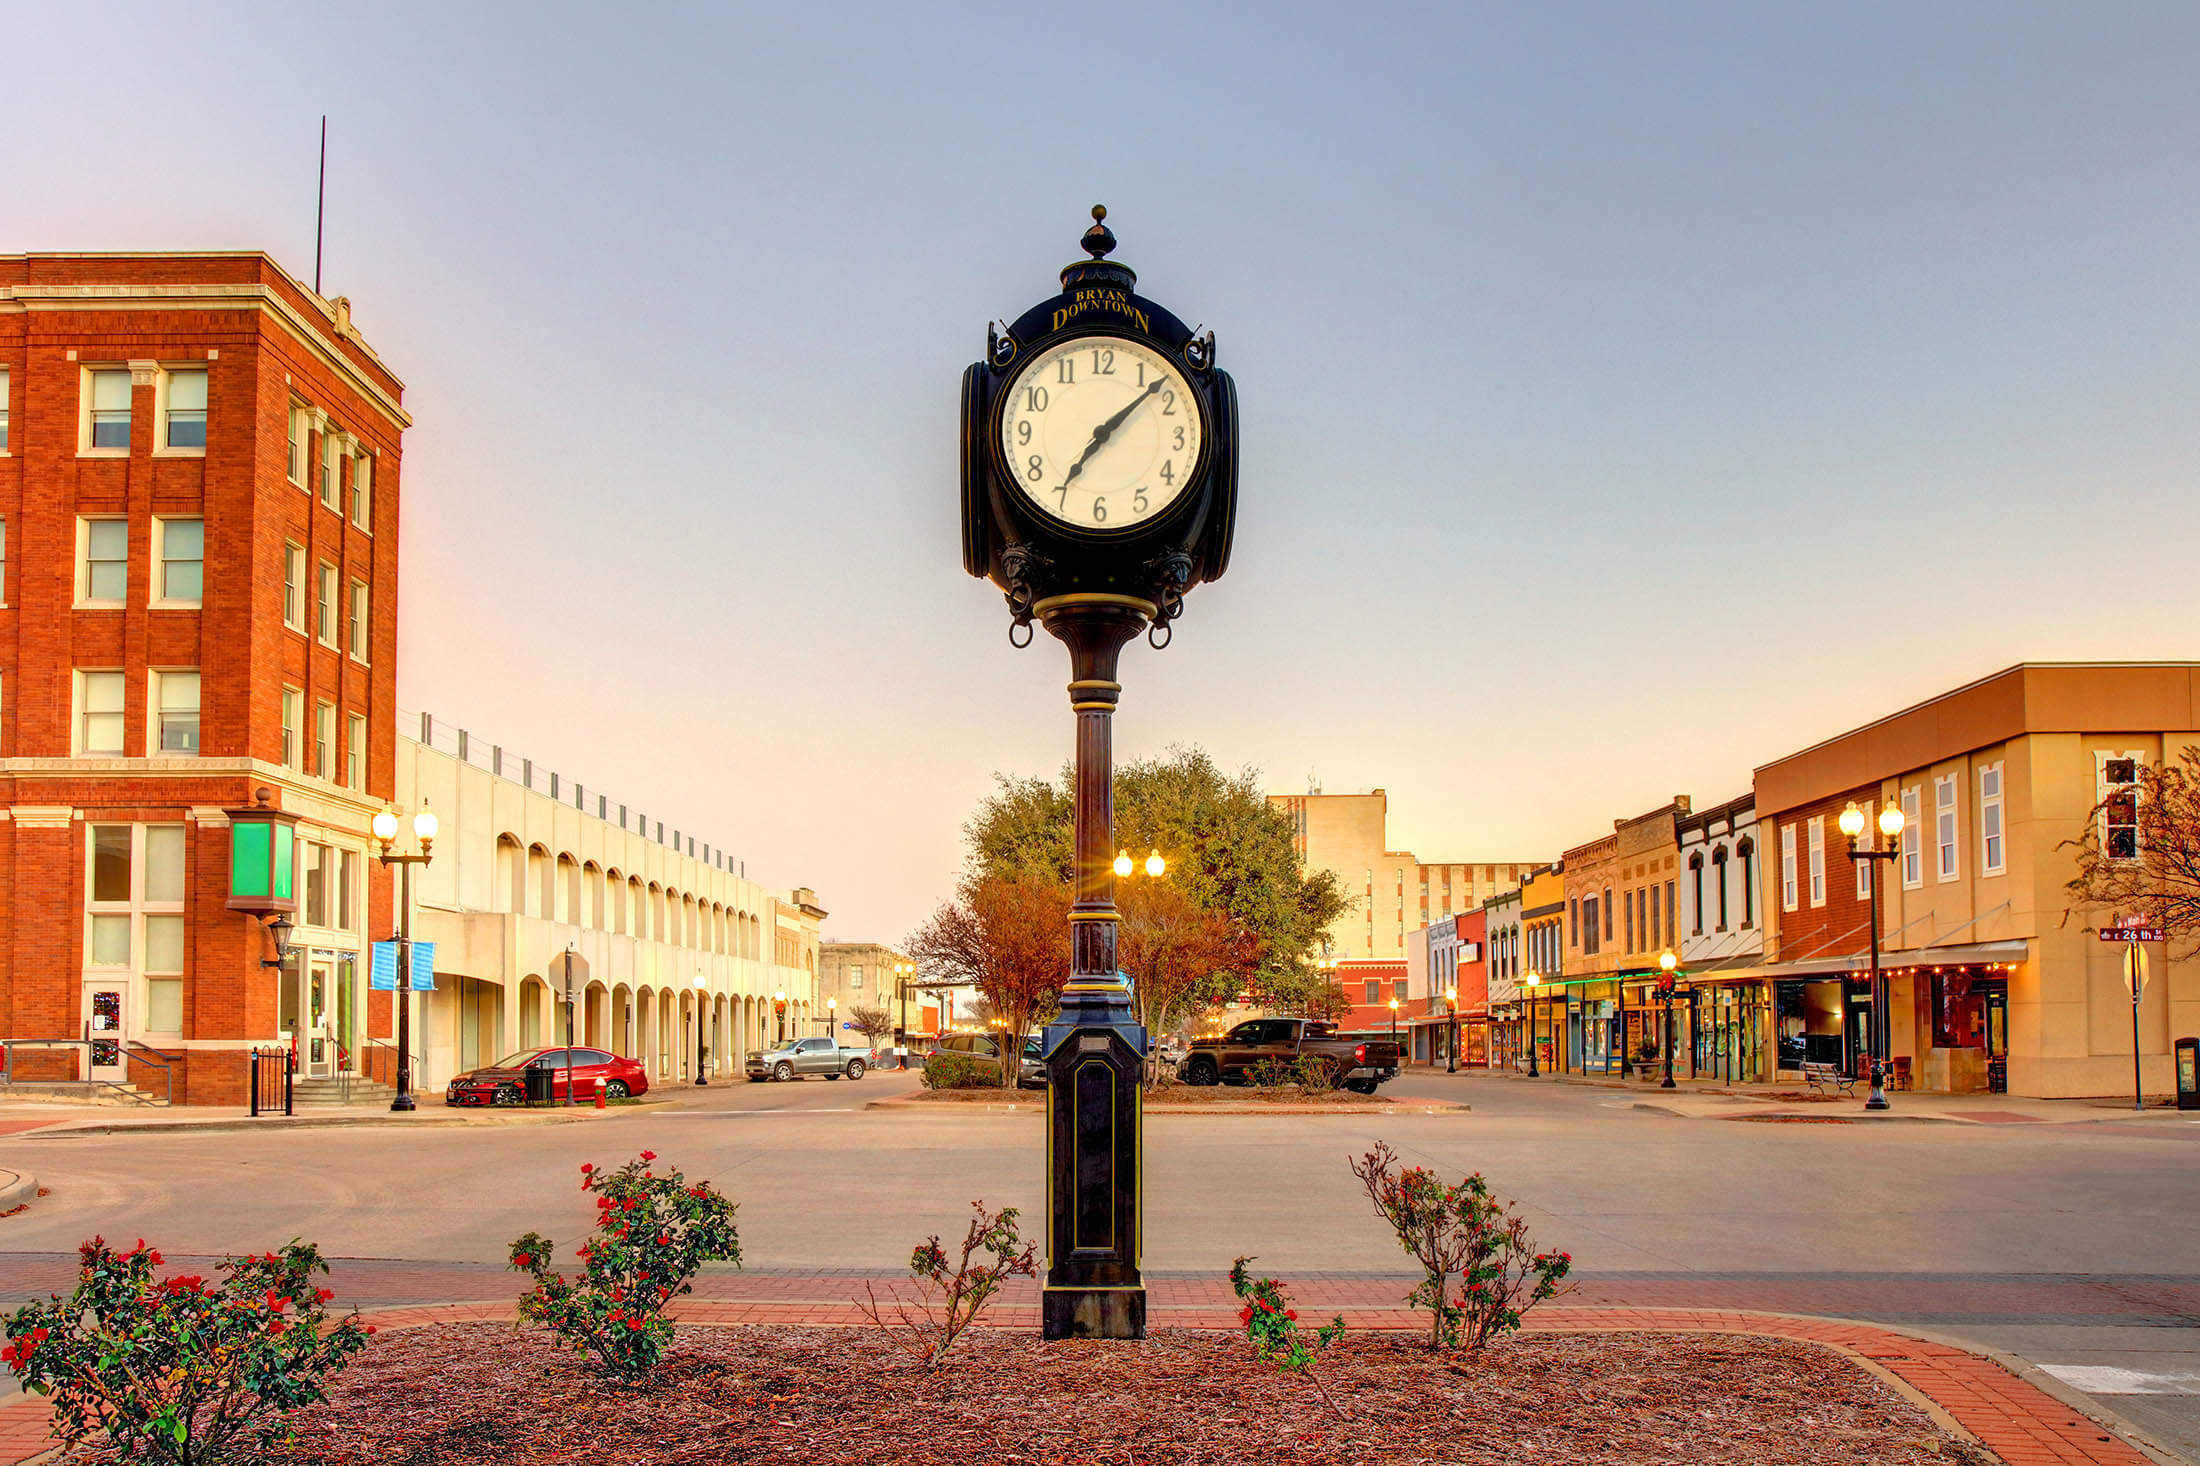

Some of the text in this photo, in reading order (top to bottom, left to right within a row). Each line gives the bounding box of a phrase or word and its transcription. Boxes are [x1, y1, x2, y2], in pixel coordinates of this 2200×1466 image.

[1076, 289, 1127, 302] BRYAN
[1057, 359, 1075, 384] 11
[1091, 350, 1116, 375] 12
[1136, 362, 1145, 388] 1
[1025, 386, 1048, 412] 10
[1161, 390, 1176, 416] 2
[1018, 420, 1032, 446] 9
[1172, 426, 1184, 451] 3
[1028, 454, 1042, 482] 8
[1160, 459, 1175, 486] 4
[1051, 485, 1068, 513] 7
[1093, 496, 1107, 522] 6
[1133, 486, 1149, 514] 5
[2123, 930, 2138, 940] 26
